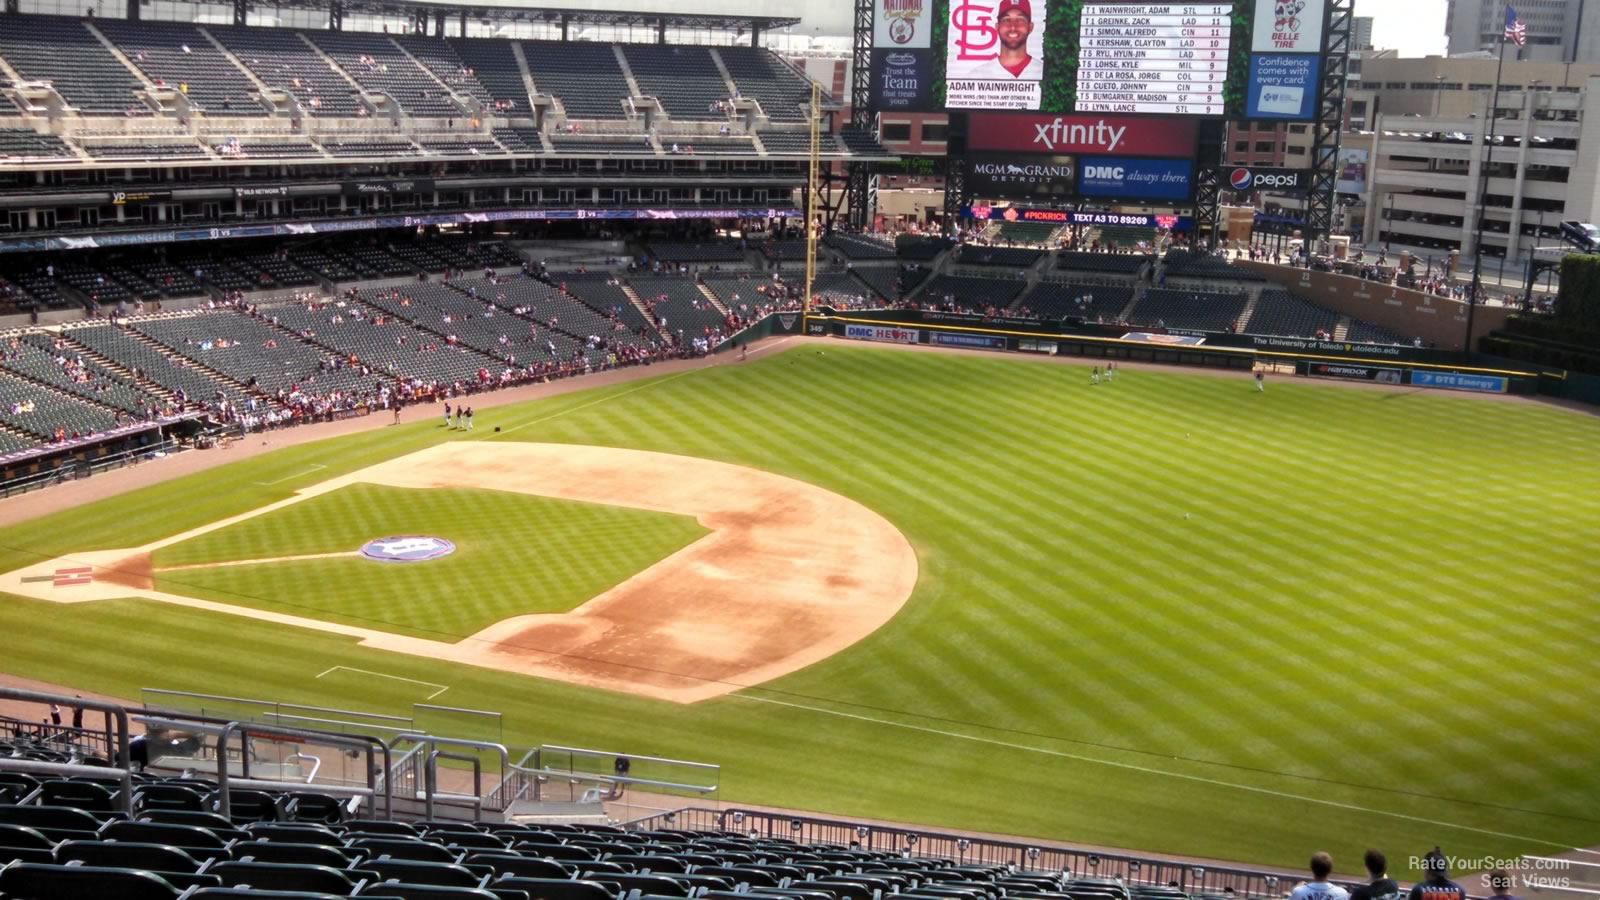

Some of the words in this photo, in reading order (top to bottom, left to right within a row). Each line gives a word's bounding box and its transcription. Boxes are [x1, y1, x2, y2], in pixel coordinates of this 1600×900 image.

[1258, 57, 1309, 66] Confidence
[882, 75, 917, 89] Team
[949, 82, 975, 91] ADAM
[978, 82, 1036, 92] WAINWRIGHT
[1257, 77, 1281, 85] every
[1034, 118, 1126, 150] xfinity
[975, 164, 1005, 174] MGM
[1025, 165, 1070, 176] GRAND
[1085, 166, 1124, 179] DMC
[1127, 170, 1159, 184] always
[1162, 171, 1187, 182] there.
[1254, 173, 1298, 187] pepsi
[113, 192, 126, 202] yp
[1024, 212, 1067, 221] #PICKRICK
[1120, 215, 1148, 224] 89269
[849, 327, 872, 336] DMC
[1269, 339, 1306, 348] University
[1352, 346, 1399, 354] utoledo.edu
[1435, 376, 1455, 384] DTE
[1458, 378, 1494, 388] Energy
